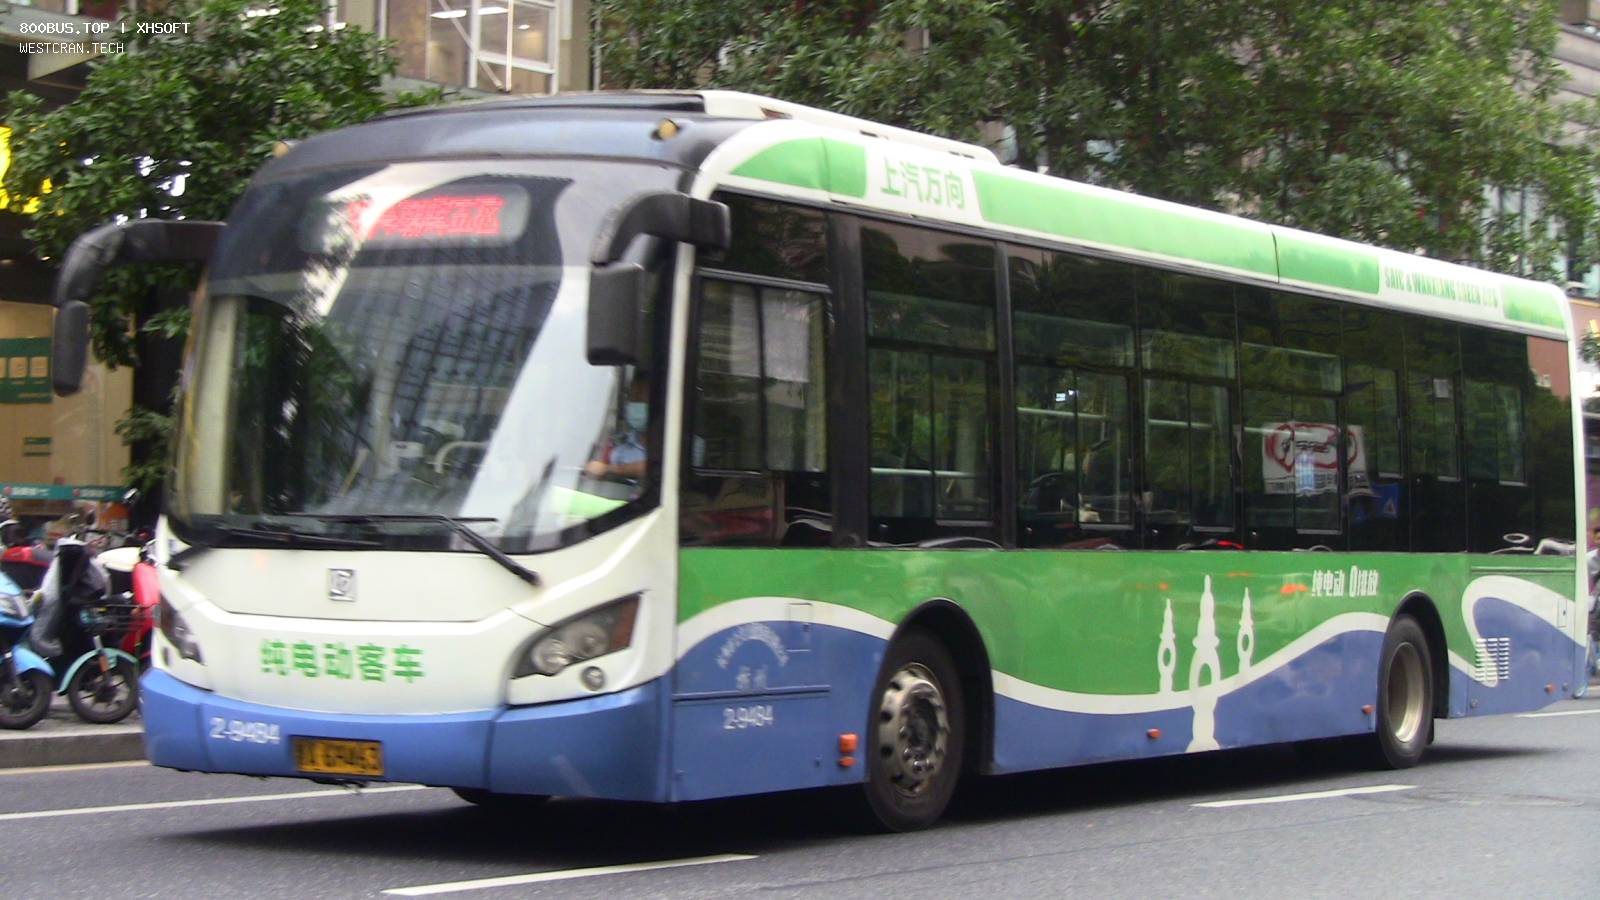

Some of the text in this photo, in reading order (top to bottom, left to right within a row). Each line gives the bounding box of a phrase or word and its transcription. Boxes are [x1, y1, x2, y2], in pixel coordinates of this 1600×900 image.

[881, 157, 965, 209] 上汽万向
[1312, 569, 1345, 597] 纯电动
[260, 639, 424, 683] 纯电动客车
